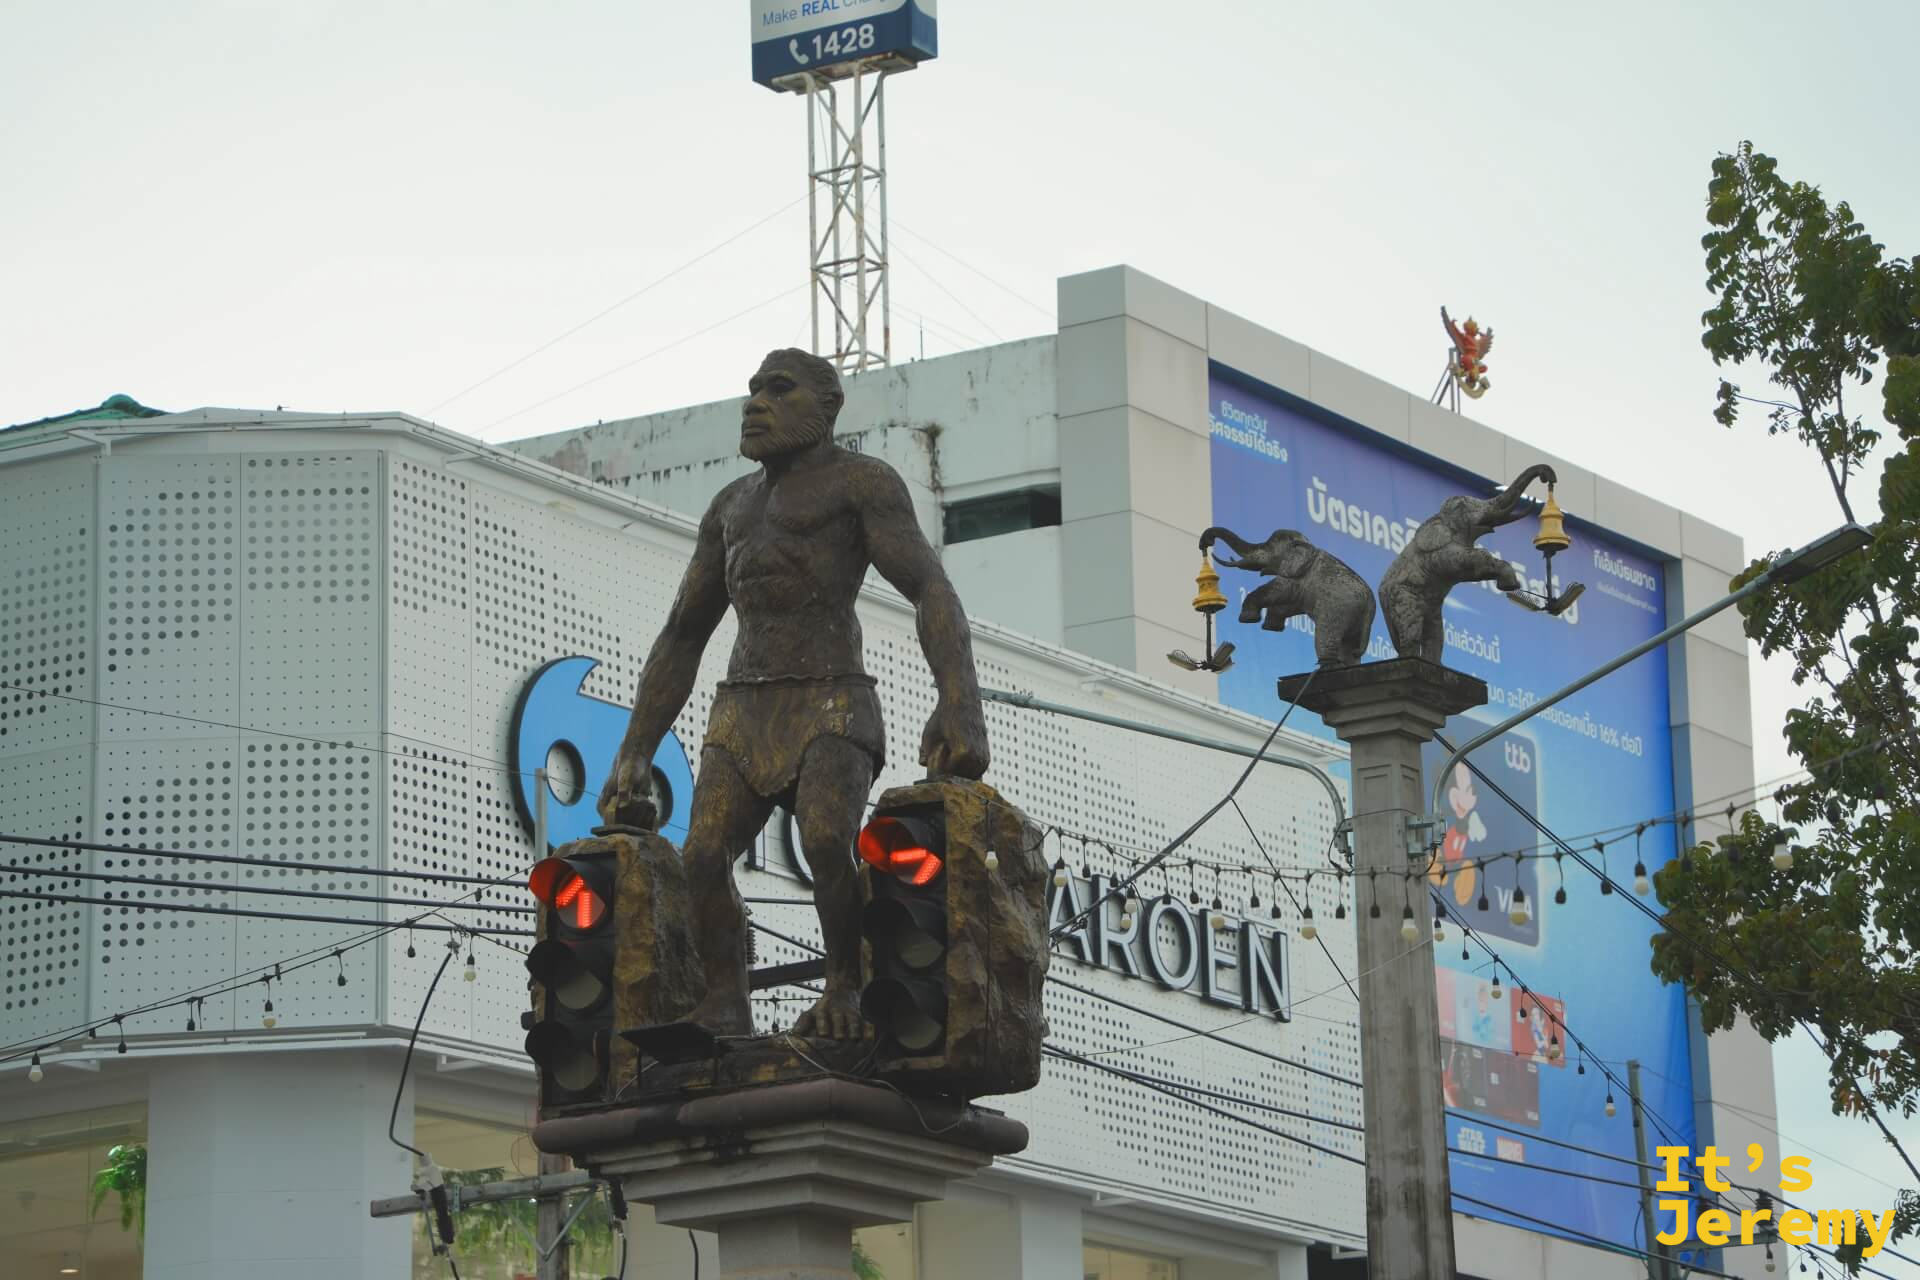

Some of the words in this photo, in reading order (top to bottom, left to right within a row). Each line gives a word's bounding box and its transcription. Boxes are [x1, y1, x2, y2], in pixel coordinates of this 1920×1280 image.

[762, 7, 798, 27] Make
[801, 0, 840, 17] REAL
[812, 23, 875, 60] 1428
[1599, 724, 1620, 746] 16%
[1504, 740, 1531, 773] ttb
[1494, 885, 1533, 921] VIA
[1046, 864, 1292, 1023] AROEN
